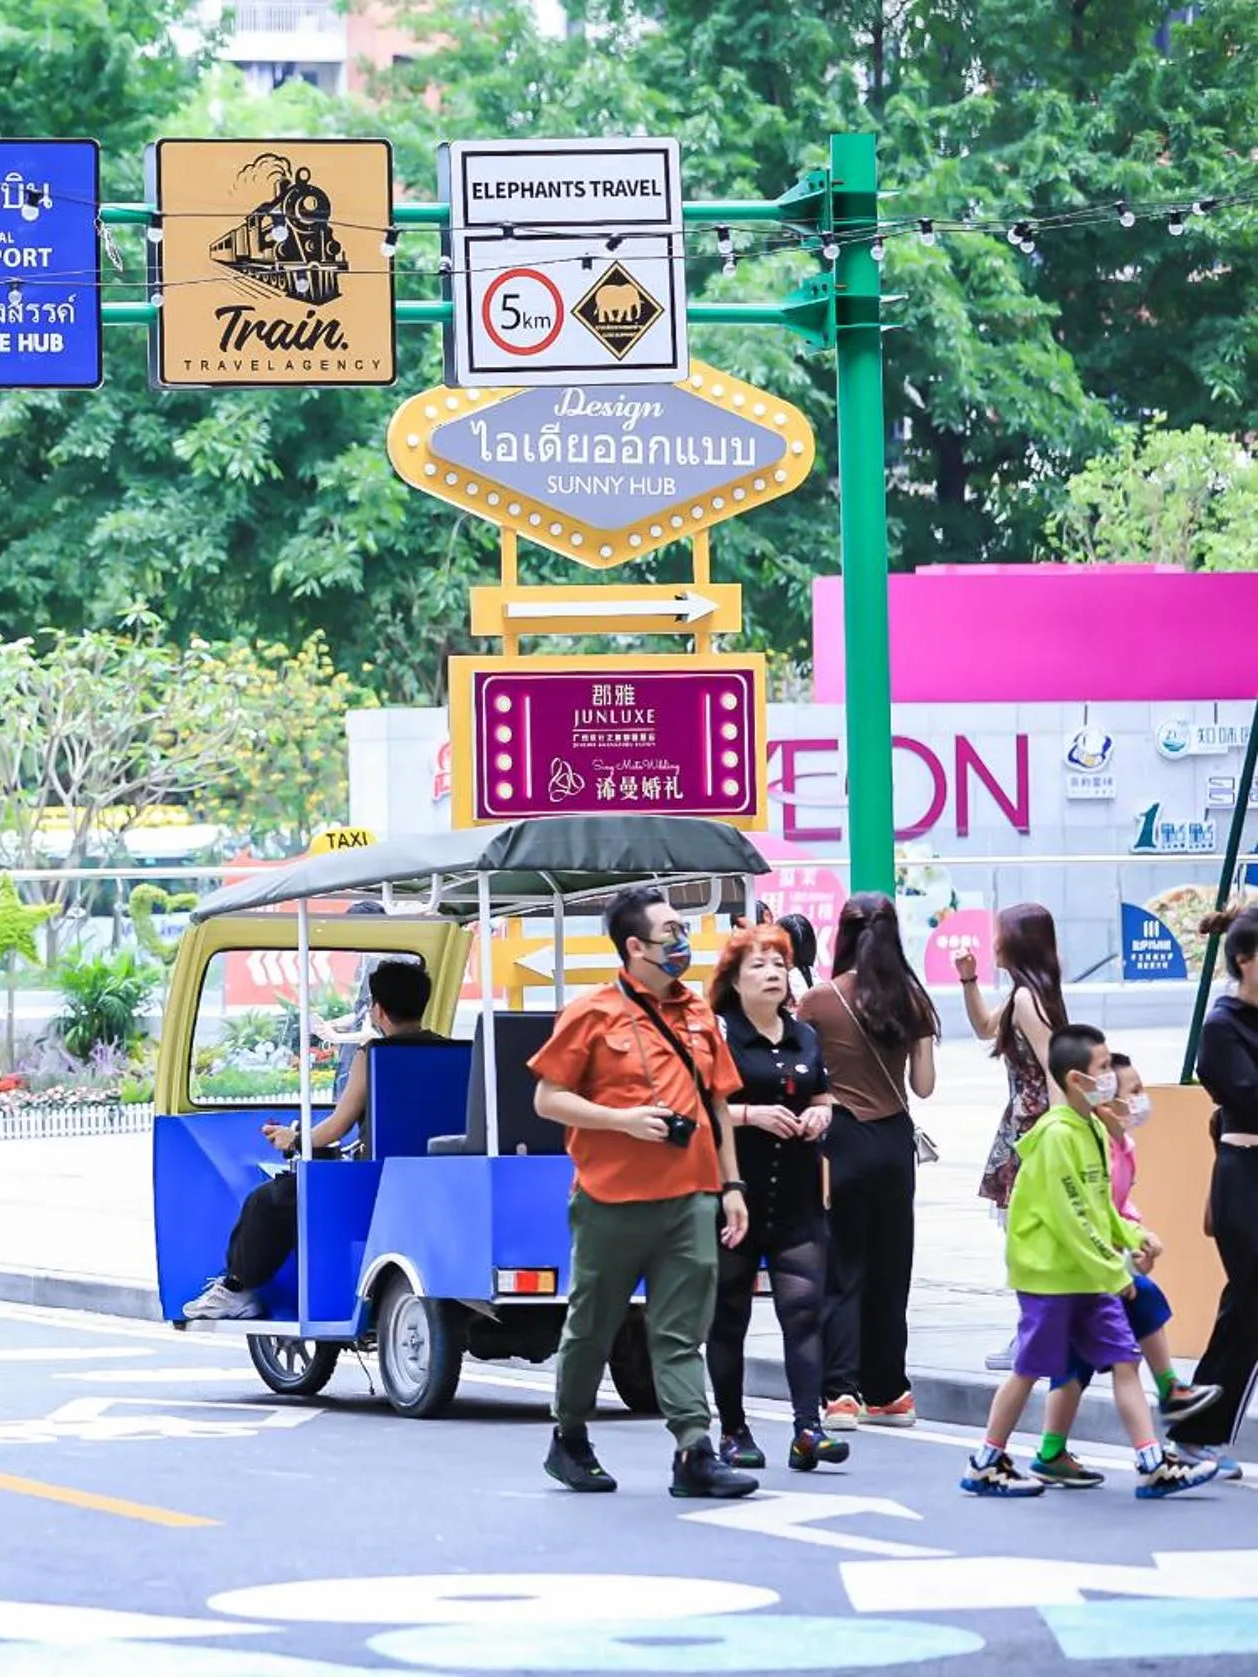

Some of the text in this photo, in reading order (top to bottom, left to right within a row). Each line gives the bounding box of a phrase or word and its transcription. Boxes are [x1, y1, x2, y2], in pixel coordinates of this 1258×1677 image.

[472, 179, 661, 200] ELEPHANTS TRAVEL
[500, 293, 551, 330] 5km
[18, 333, 65, 353] HUB
[554, 386, 663, 430] Design
[470, 419, 756, 466] ไอเดียออกแบบ
[547, 474, 677, 496] SUNNY HUB
[574, 708, 655, 726] JUNLUXE
[326, 832, 368, 849] TAXI
